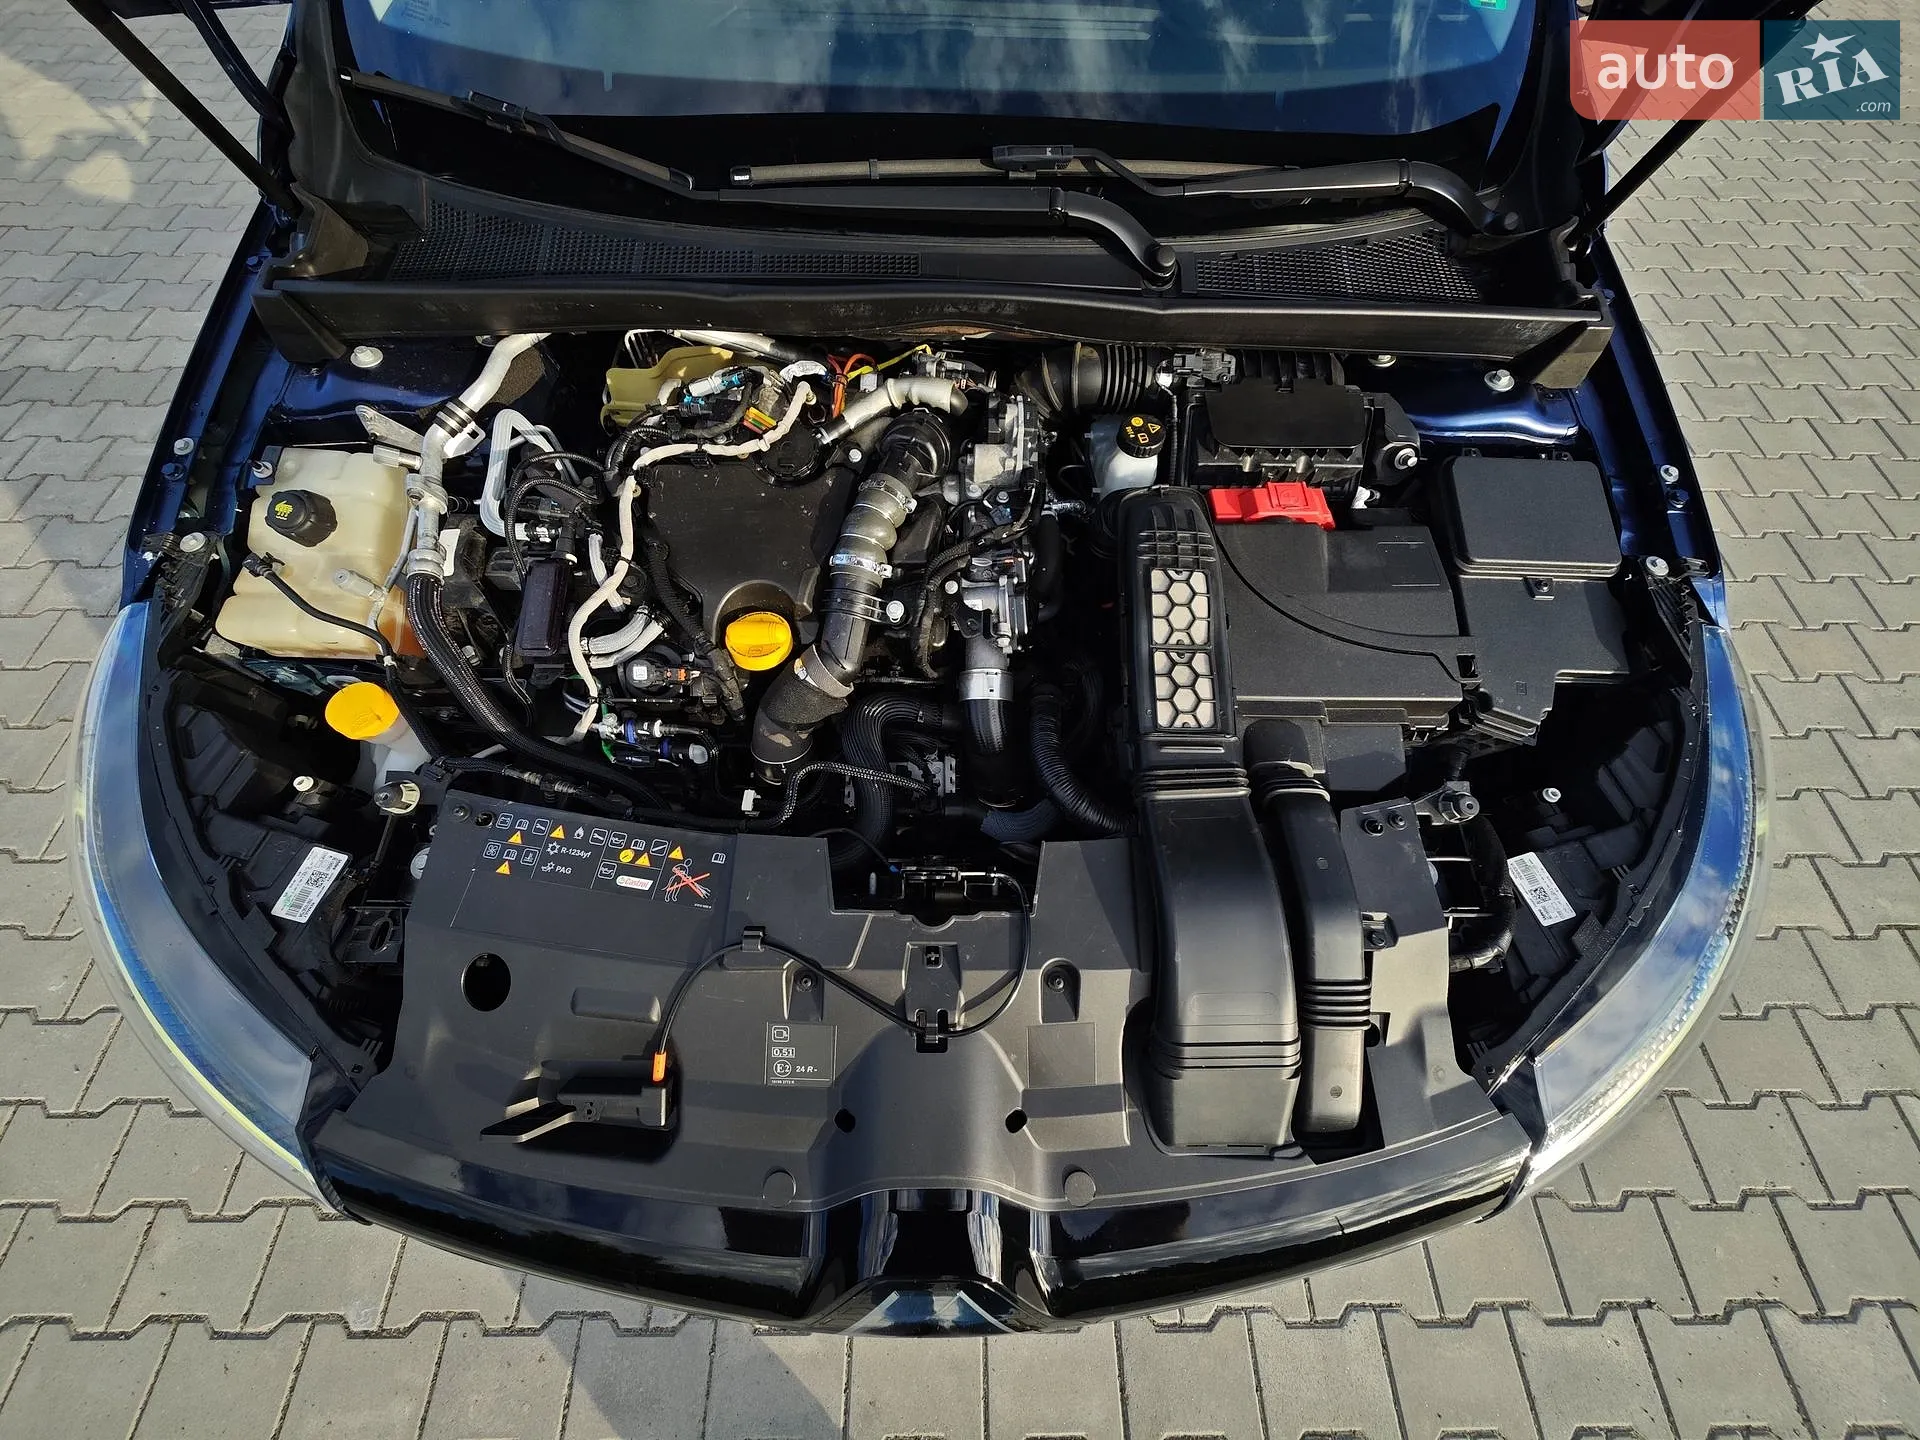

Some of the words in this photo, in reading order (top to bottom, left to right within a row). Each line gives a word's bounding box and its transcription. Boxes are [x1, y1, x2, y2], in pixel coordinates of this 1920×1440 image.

[560, 846, 592, 859] R-1234yf
[555, 865, 572, 875] PAG
[624, 877, 650, 888] Castrol
[796, 1065, 806, 1073] 24
